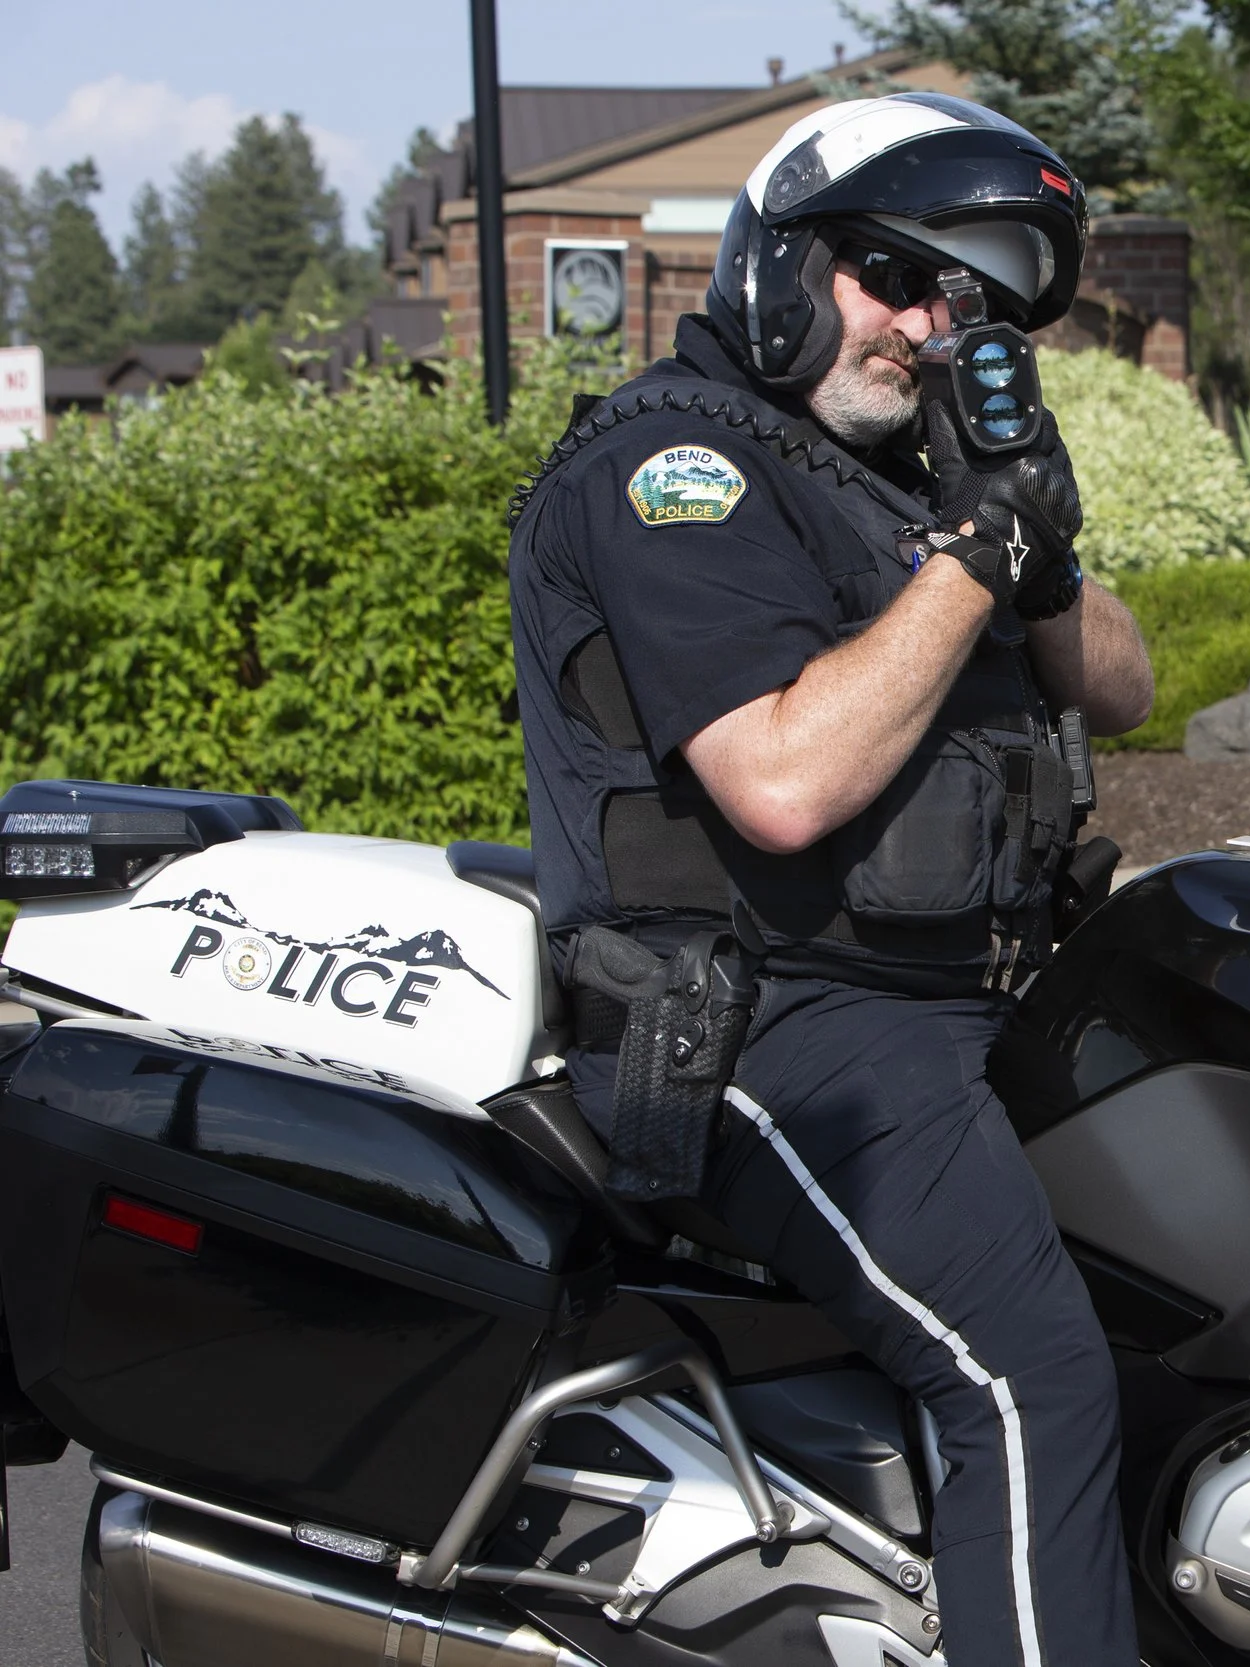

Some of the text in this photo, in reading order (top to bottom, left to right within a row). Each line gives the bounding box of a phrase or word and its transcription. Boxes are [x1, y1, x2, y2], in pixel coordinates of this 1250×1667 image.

[664, 449, 713, 465] BEND
[655, 504, 714, 520] POLICE
[170, 925, 441, 1028] POLICE
